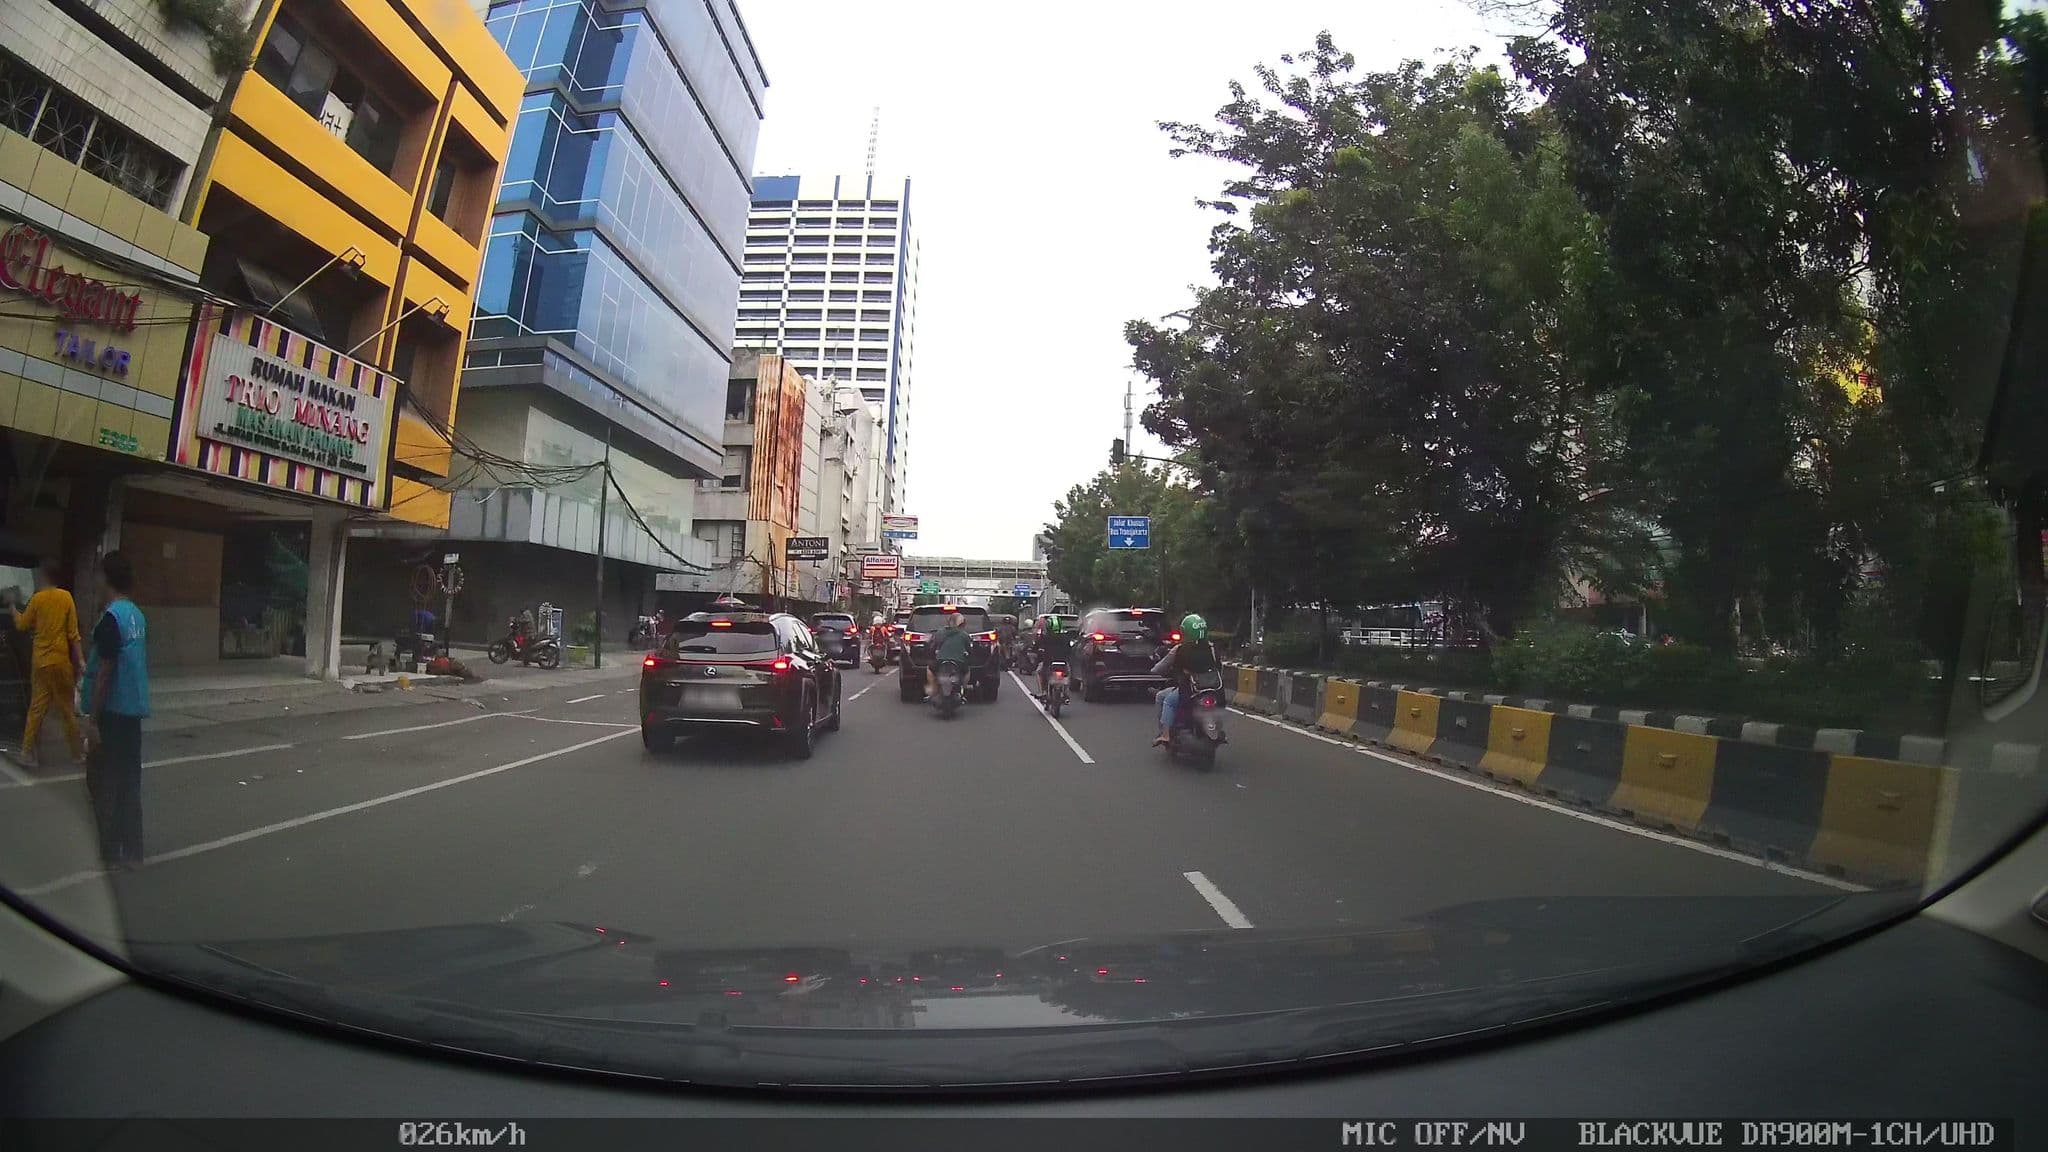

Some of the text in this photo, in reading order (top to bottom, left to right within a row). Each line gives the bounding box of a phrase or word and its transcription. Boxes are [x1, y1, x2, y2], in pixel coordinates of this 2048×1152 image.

[0, 222, 143, 335] Elegant
[55, 328, 131, 377] TAILOR
[225, 374, 370, 444] TRIO MINANG
[251, 356, 357, 412] RUMAH MAKAN
[791, 538, 825, 547] ANTONI
